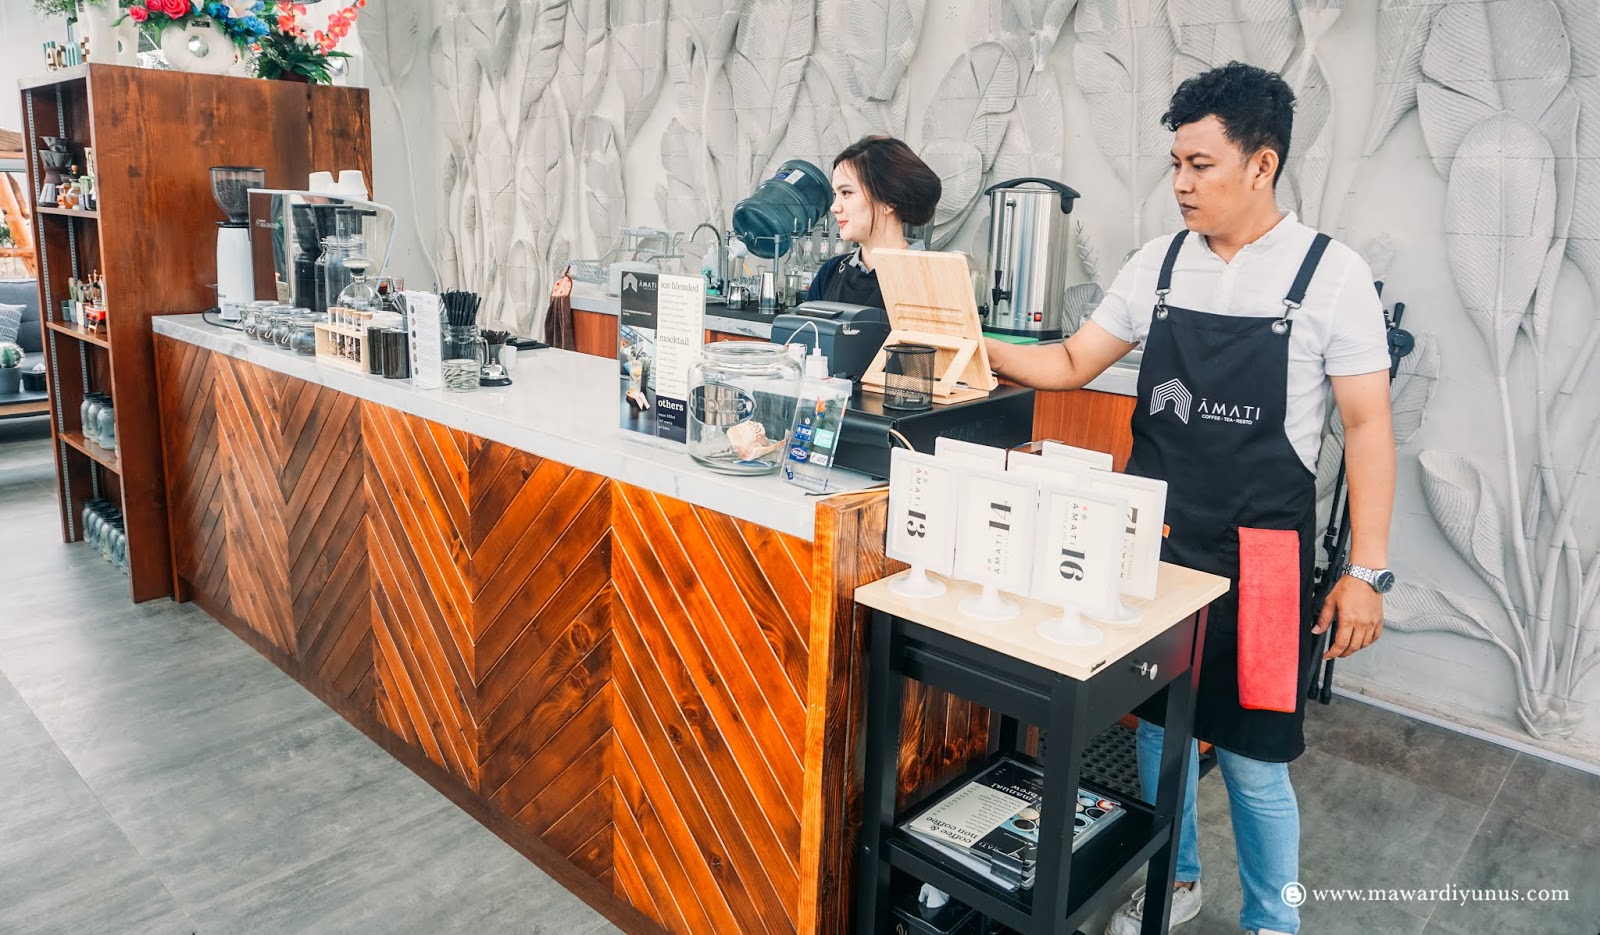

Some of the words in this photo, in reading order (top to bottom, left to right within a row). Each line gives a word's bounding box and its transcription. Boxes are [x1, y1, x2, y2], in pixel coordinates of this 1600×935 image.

[672, 281, 699, 293] blended
[659, 334, 690, 346] mocktail
[658, 399, 684, 412] others
[914, 467, 923, 507] AMATI
[906, 509, 927, 539] 13
[989, 501, 1012, 532] 14
[1070, 503, 1079, 545] AMATI
[995, 534, 1003, 575] AMATI
[1059, 545, 1085, 582] 16
[991, 782, 1033, 801] manual
[1010, 785, 1038, 798] brew
[925, 816, 956, 833] coffee
[929, 824, 940, 832] &
[941, 828, 972, 845] coffee
[958, 828, 978, 840] non
